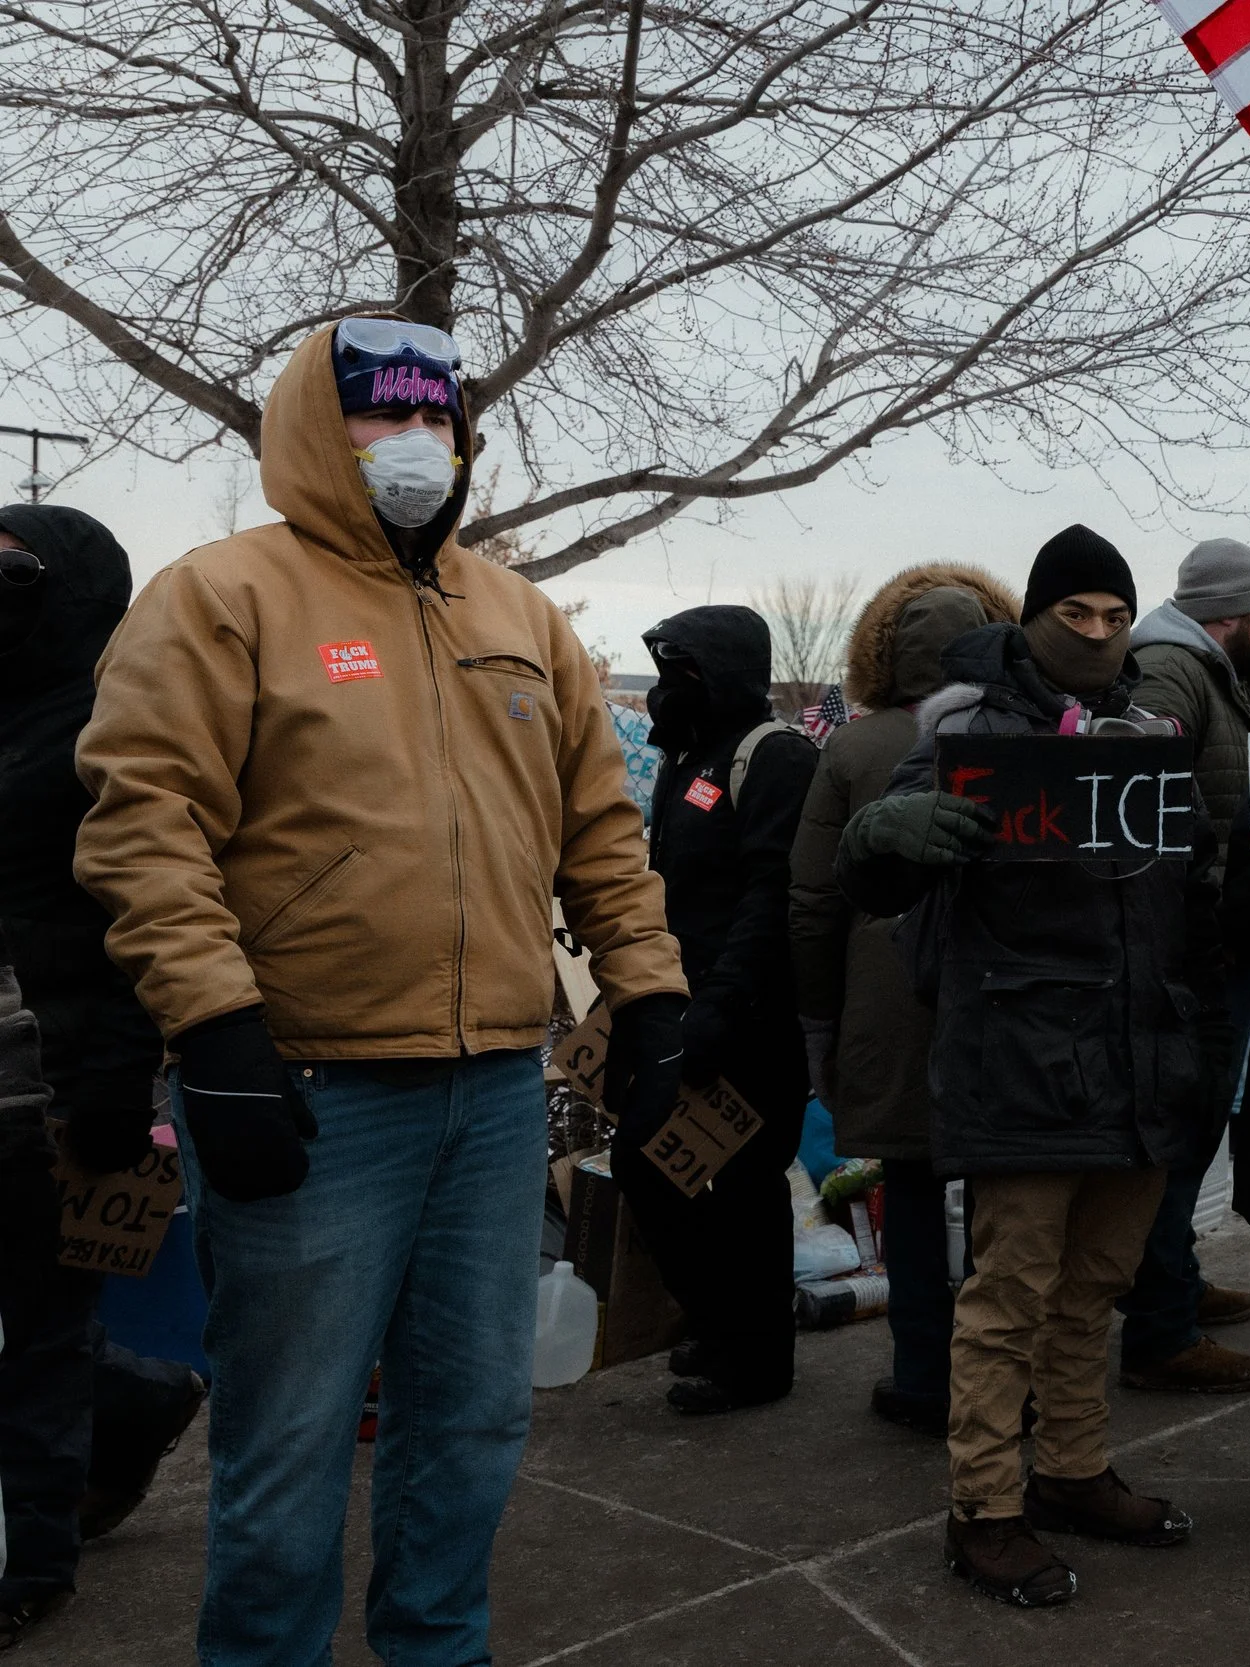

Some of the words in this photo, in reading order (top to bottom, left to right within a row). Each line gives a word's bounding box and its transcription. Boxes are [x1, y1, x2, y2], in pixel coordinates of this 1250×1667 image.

[371, 365, 448, 405] Wolves
[328, 659, 378, 674] TRUMP
[689, 788, 714, 806] TRUMP
[1075, 769, 1193, 856] ICE
[703, 1083, 757, 1136] RESI
[654, 1130, 707, 1188] ICE
